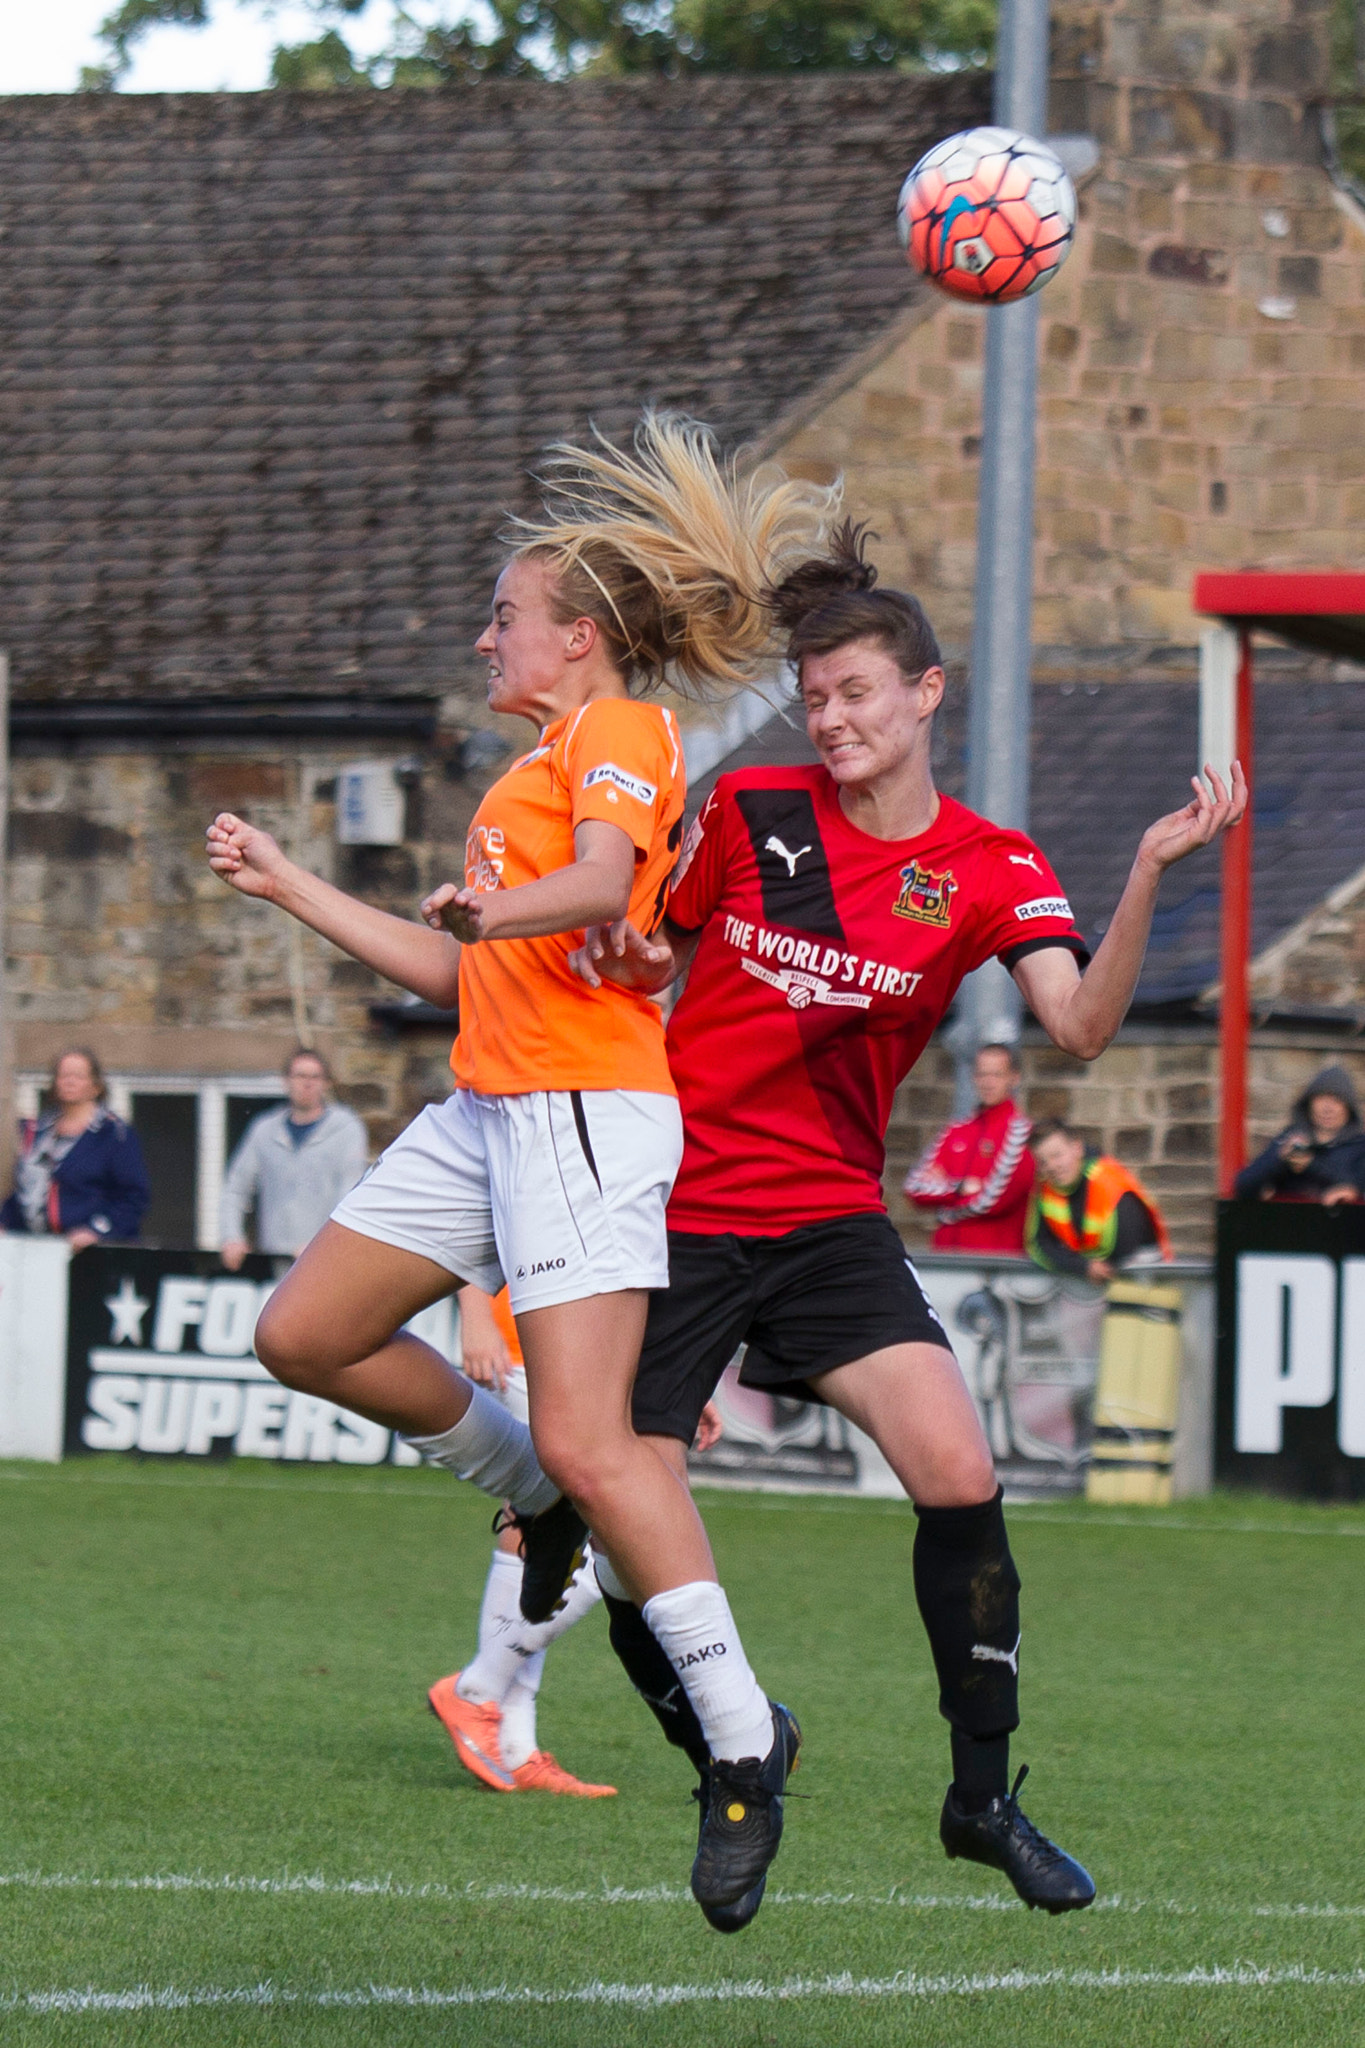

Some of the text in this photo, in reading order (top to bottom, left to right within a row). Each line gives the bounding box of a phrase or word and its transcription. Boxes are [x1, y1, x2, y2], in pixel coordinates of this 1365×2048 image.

[597, 768, 635, 791] Respect
[723, 914, 924, 998] THE WORLD'S FIRST
[745, 962, 778, 984] INTEGRITY
[790, 972, 819, 988] RESPECT
[825, 994, 867, 1006] COMMUNITY
[529, 1257, 567, 1276] JAKO
[677, 1641, 727, 1670] JAKO
